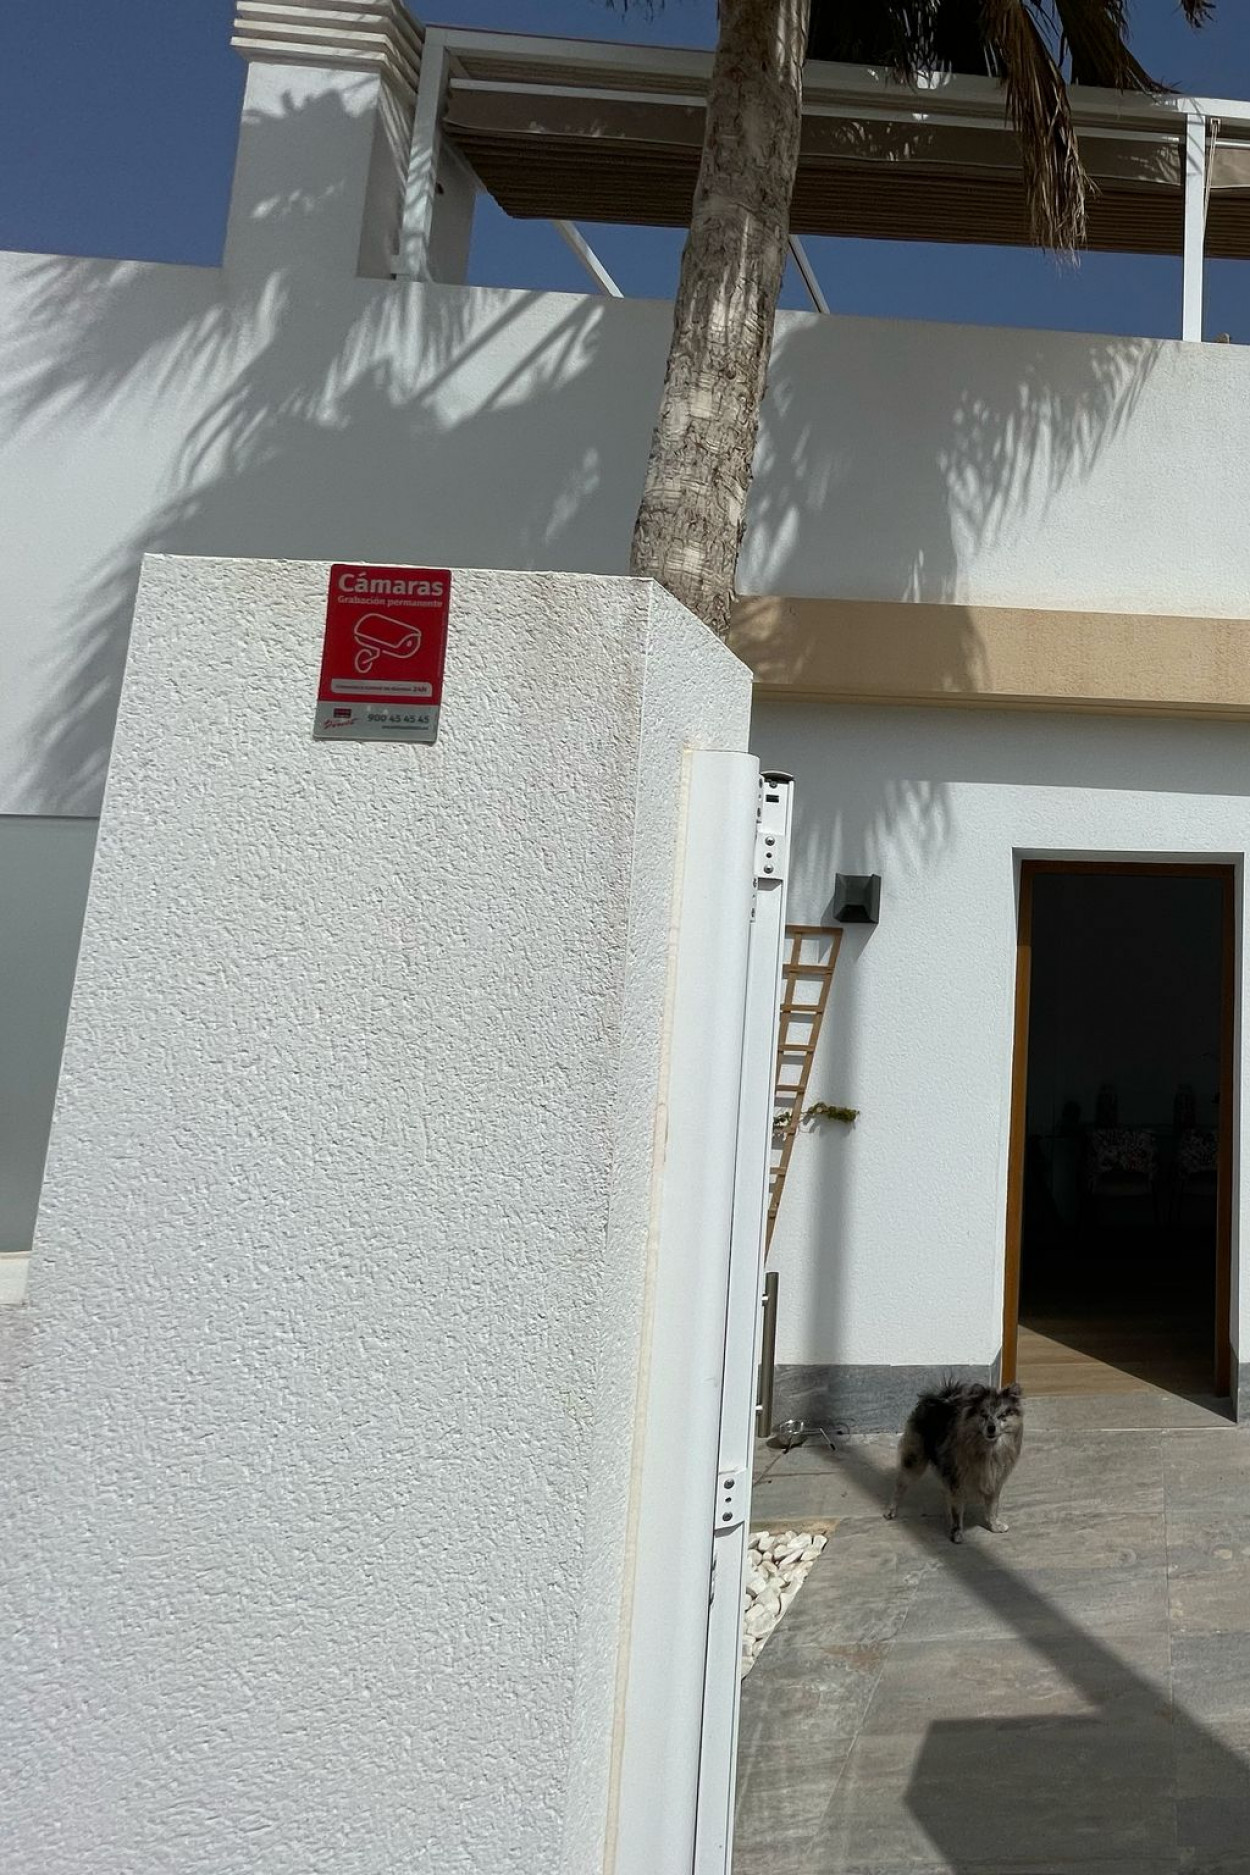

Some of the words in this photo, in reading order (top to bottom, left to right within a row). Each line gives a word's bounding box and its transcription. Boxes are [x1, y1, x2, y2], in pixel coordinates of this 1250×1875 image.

[338, 571, 443, 596] Cámaras
[337, 595, 385, 605] Grabación
[387, 598, 443, 608] permanente
[367, 713, 387, 722] 900
[389, 714, 401, 723] 45
[403, 714, 416, 723] 45
[418, 715, 430, 724] 45
